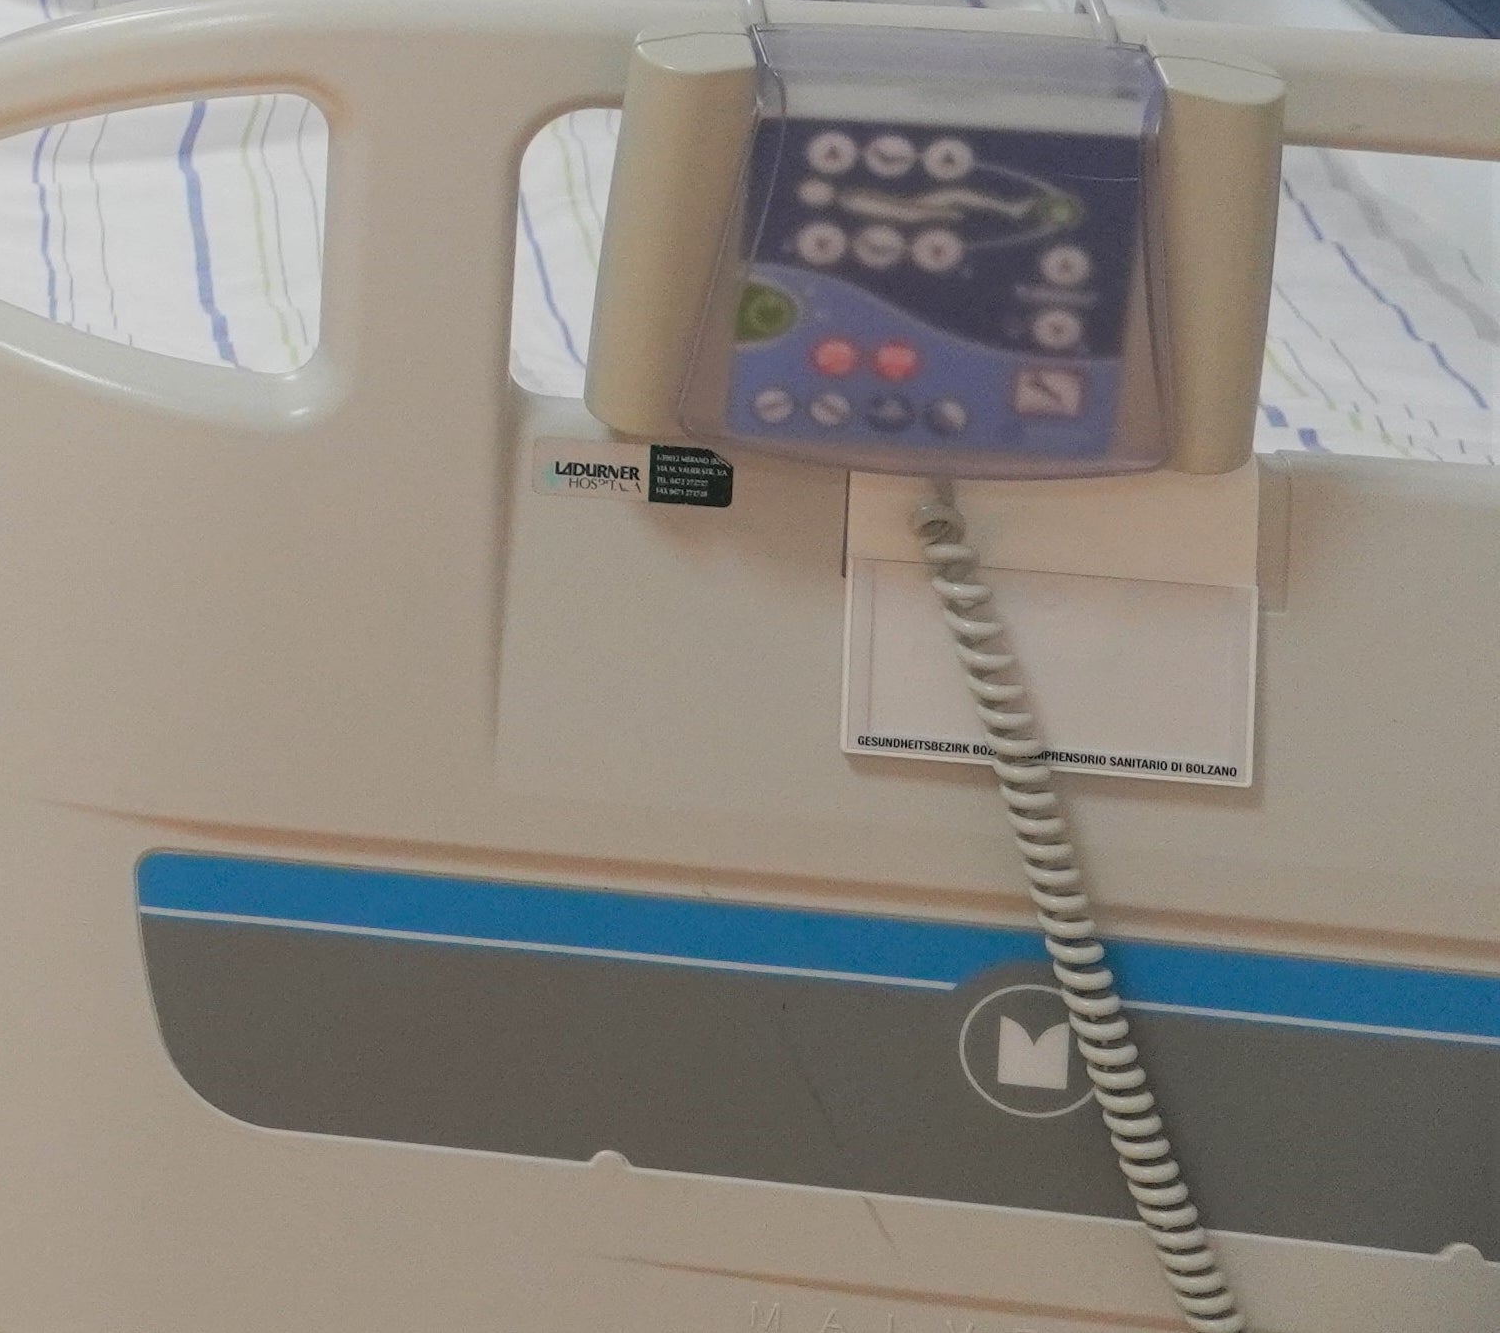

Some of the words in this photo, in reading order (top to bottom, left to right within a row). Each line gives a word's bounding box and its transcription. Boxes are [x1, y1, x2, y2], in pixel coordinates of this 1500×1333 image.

[555, 461, 640, 481] LADURNER
[857, 735, 970, 754] GESUNDHEITSBEZIRK
[1021, 749, 1107, 766] MPRENSORIO
[1110, 756, 1168, 771] SANITARIO
[1171, 761, 1182, 772] DI
[1185, 762, 1238, 777] BOLZANO
